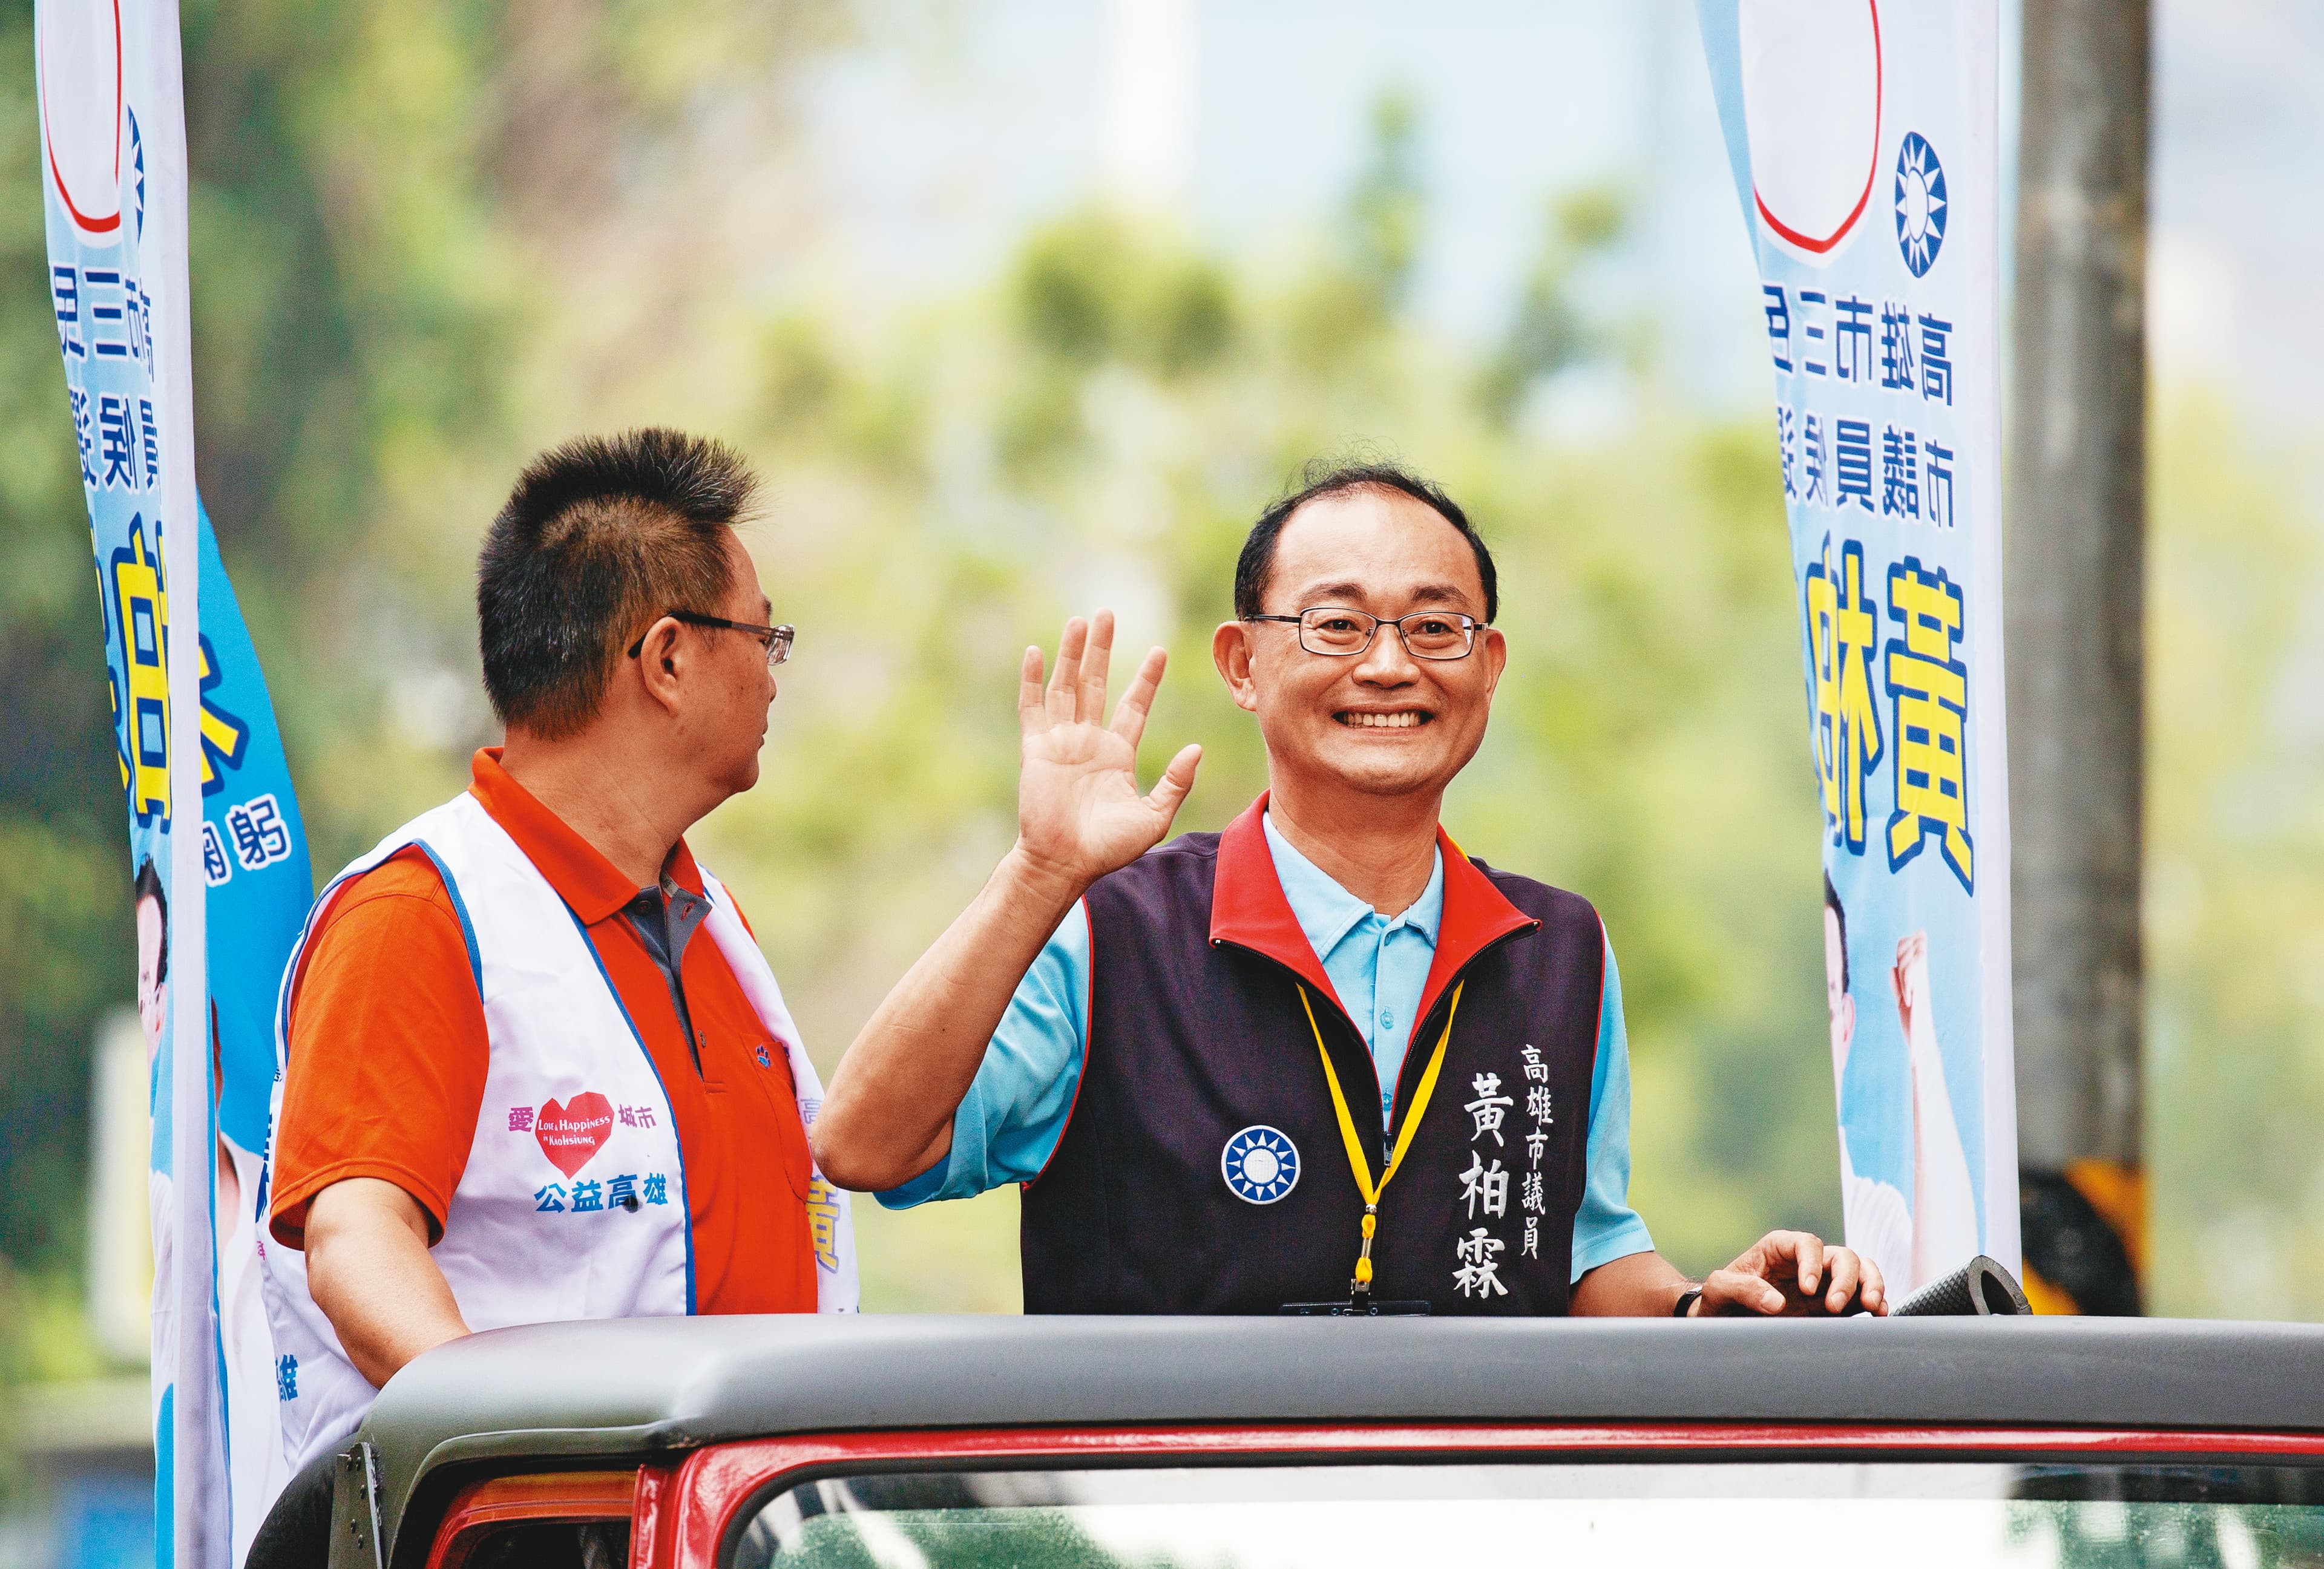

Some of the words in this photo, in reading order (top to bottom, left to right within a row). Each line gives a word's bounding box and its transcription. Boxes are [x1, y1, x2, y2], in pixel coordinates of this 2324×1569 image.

[508, 1106, 534, 1132] 愛
[619, 1104, 657, 1128] 城市
[1521, 1044, 1553, 1259] 高雄市議員
[534, 1172, 668, 1213] 公益高雄
[1452, 1072, 1513, 1299] 黃柏霖
